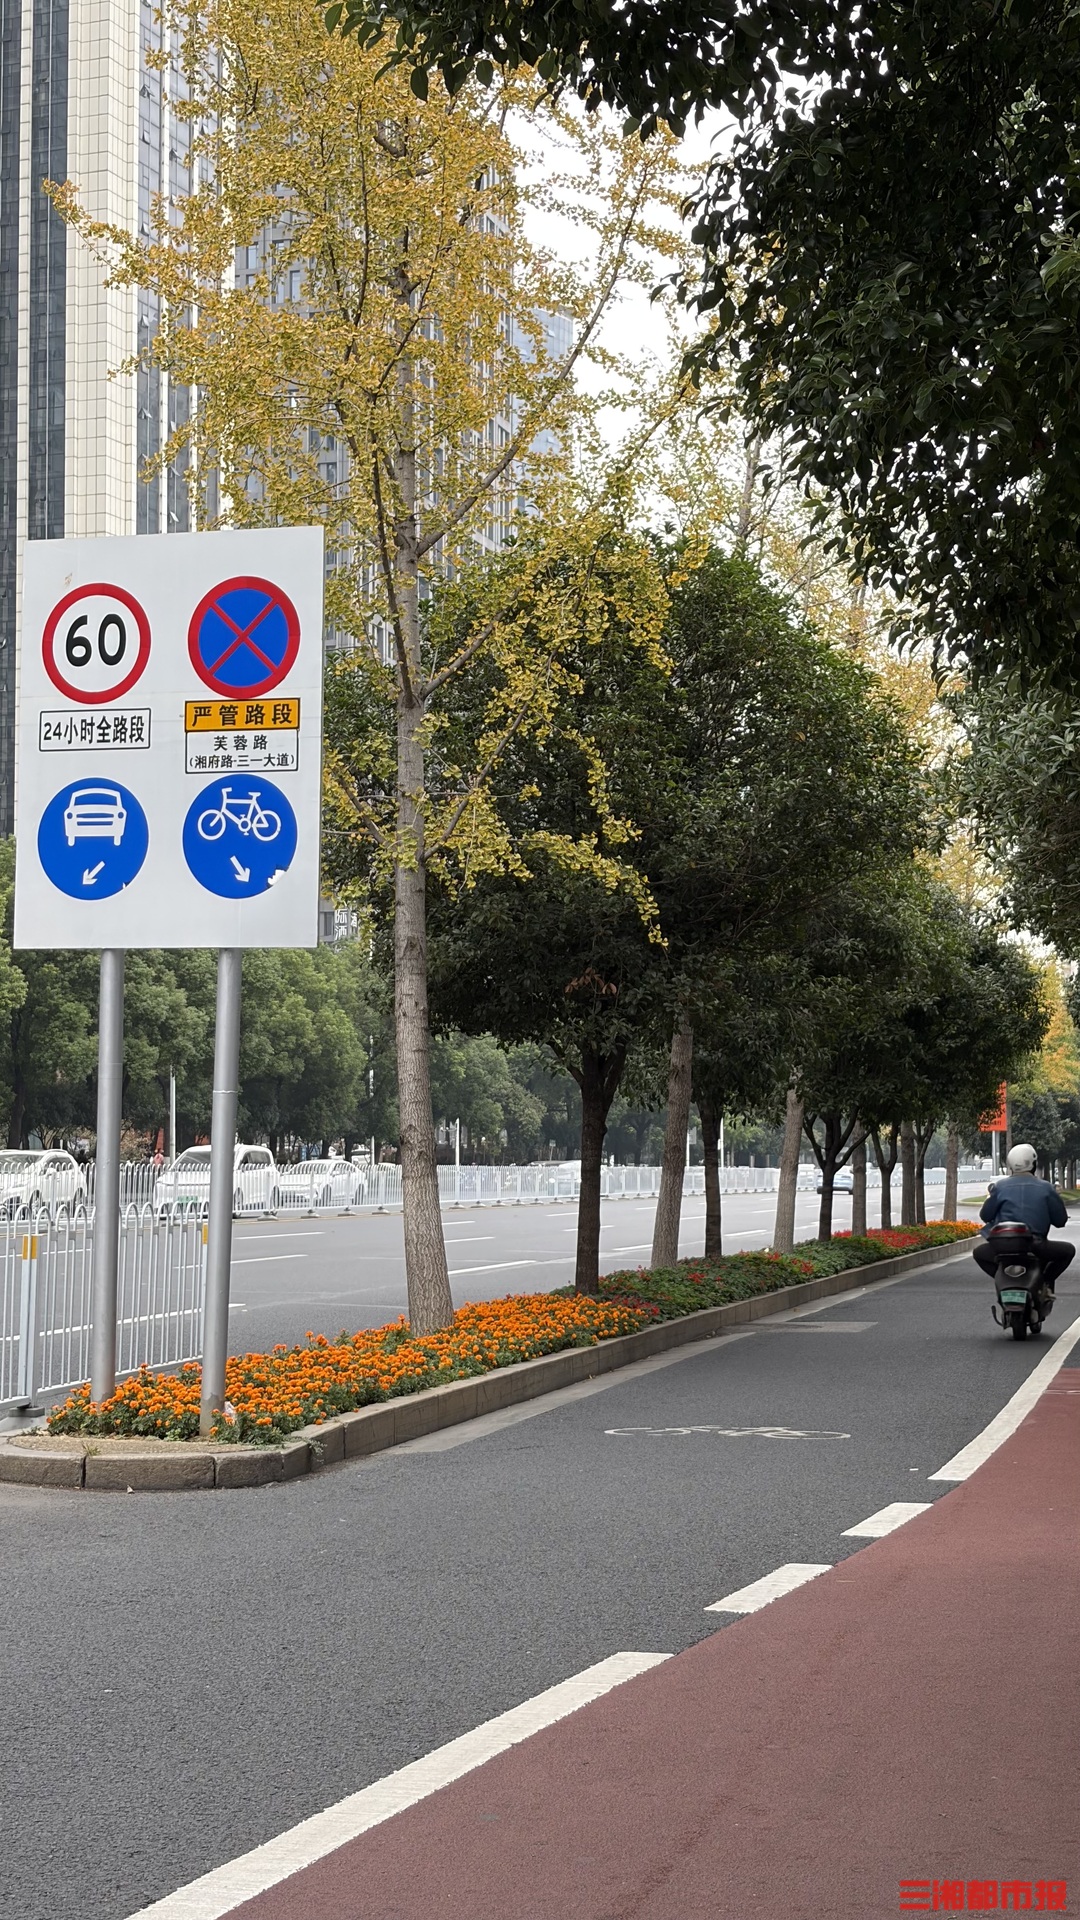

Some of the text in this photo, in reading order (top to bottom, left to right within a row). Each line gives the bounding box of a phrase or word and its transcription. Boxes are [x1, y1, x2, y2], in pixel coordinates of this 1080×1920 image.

[65, 613, 126, 667] 60
[192, 703, 292, 727] 严管路段
[43, 715, 145, 745] 24小时全路段
[213, 734, 269, 751] 芙蓉路
